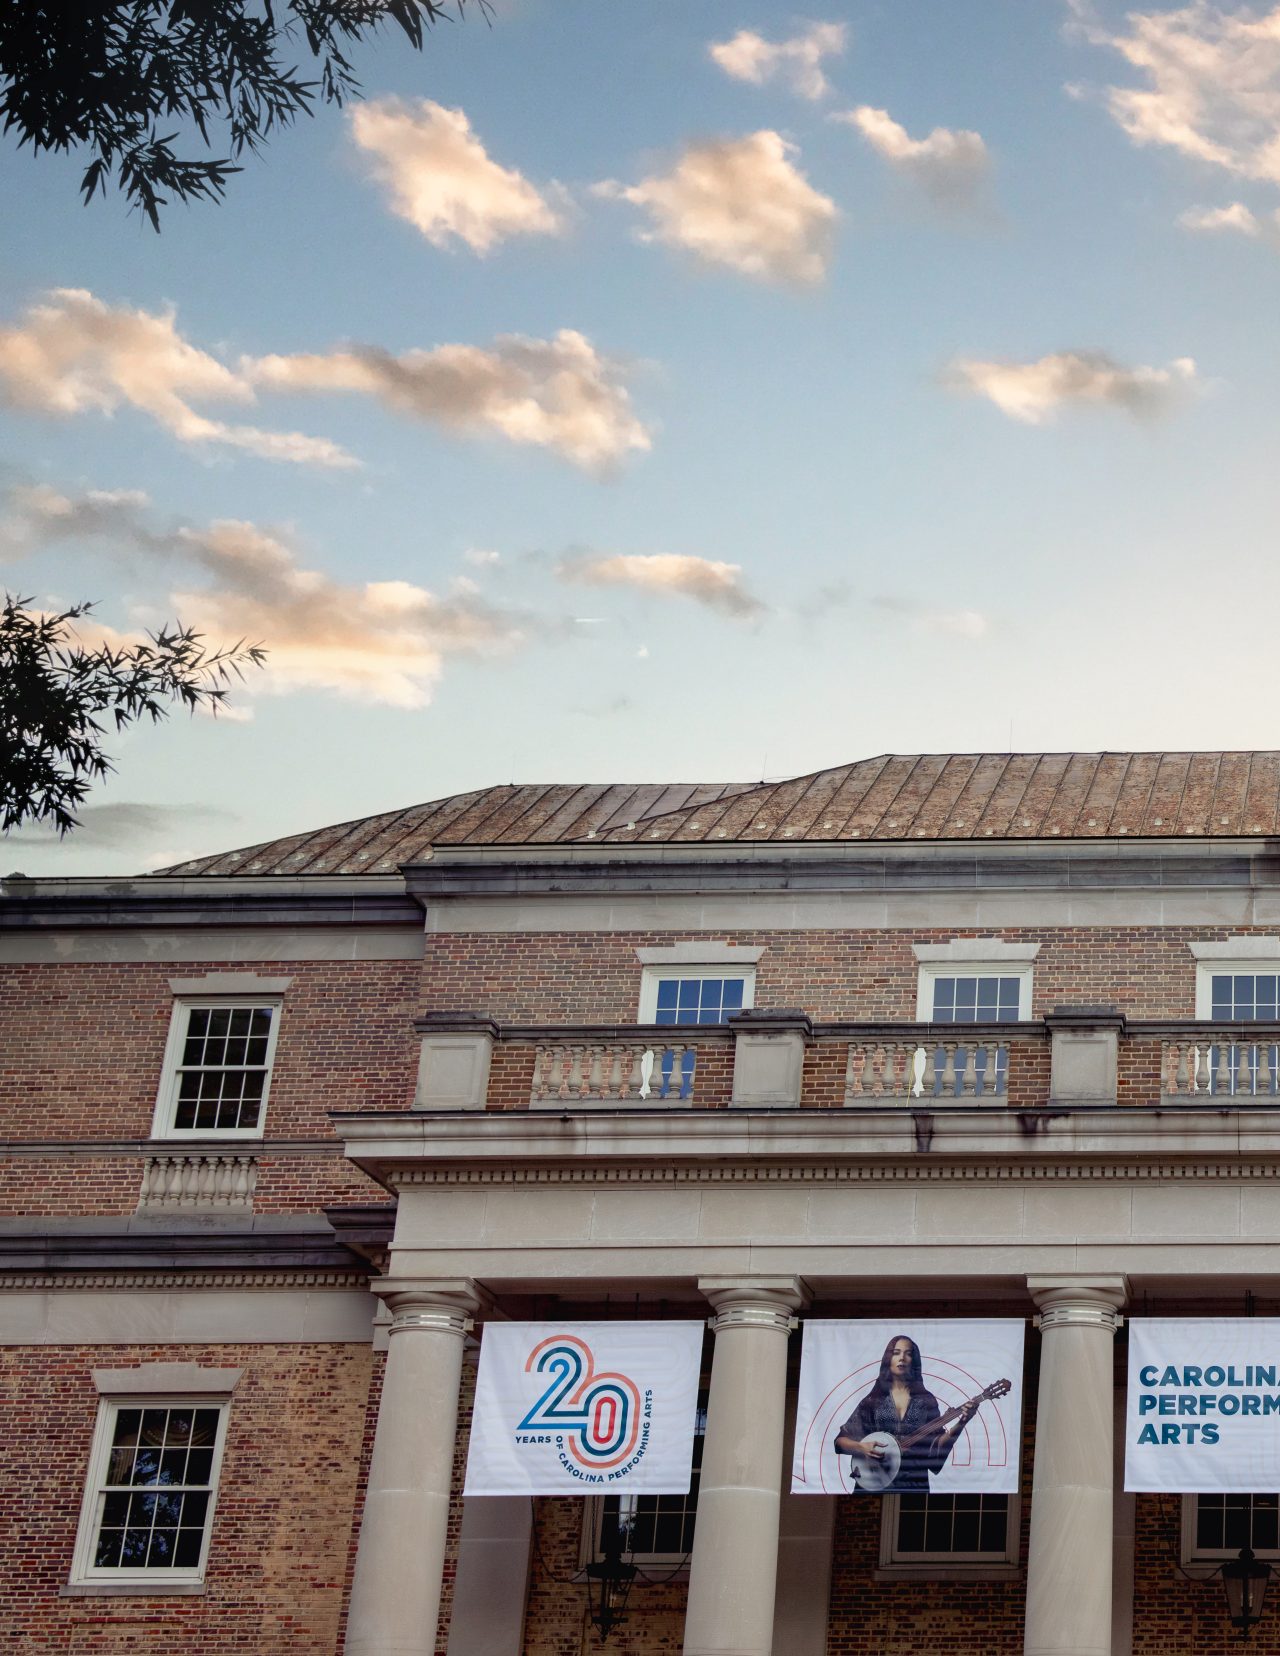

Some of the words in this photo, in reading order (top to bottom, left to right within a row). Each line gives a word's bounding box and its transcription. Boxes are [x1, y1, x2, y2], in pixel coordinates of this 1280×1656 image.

[516, 1334, 641, 1469] 20
[644, 1389, 653, 1419] ARTS
[515, 1435, 552, 1444] YEARS
[555, 1435, 564, 1450] OF
[1137, 1423, 1220, 1445] ARTS
[608, 1421, 651, 1482] PERFORMING
[558, 1452, 605, 1483] CAROLINA
